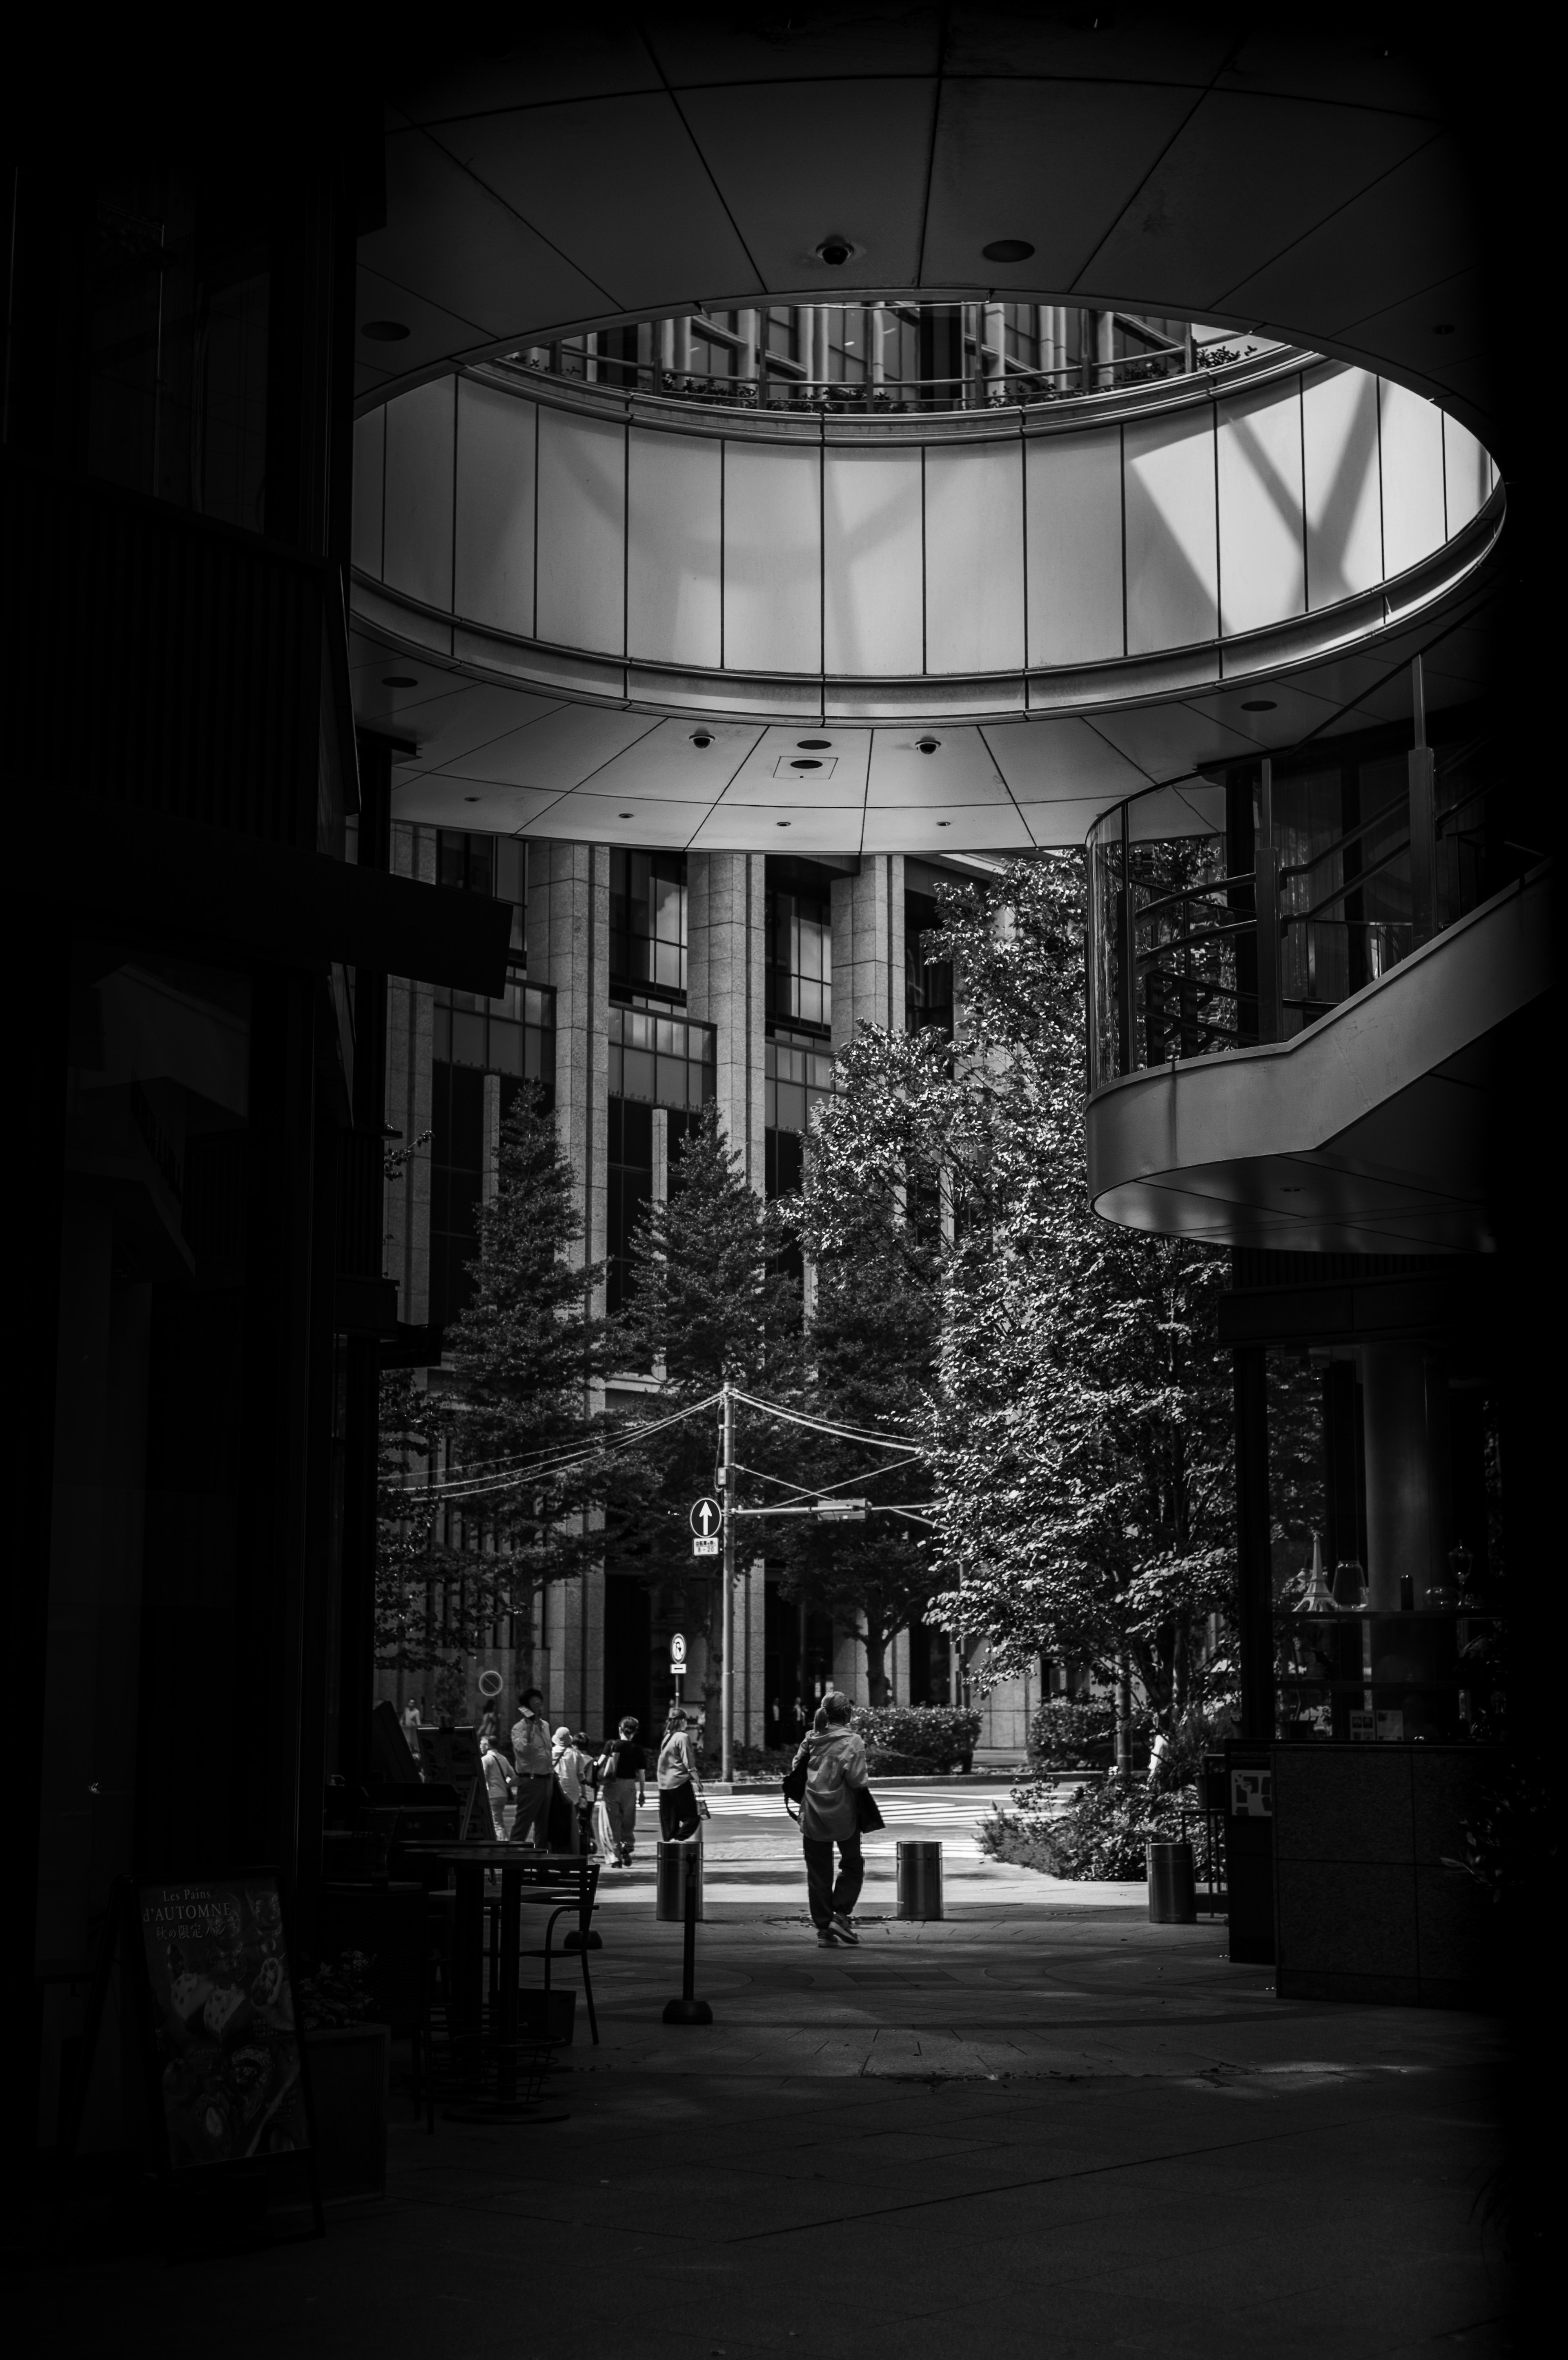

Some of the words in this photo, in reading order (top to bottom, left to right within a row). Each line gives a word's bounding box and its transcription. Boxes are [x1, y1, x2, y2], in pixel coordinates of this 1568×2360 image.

[163, 1891, 180, 1902] Les
[184, 1888, 211, 1900] Pains
[156, 1923, 226, 1941] 秋の限定パン
